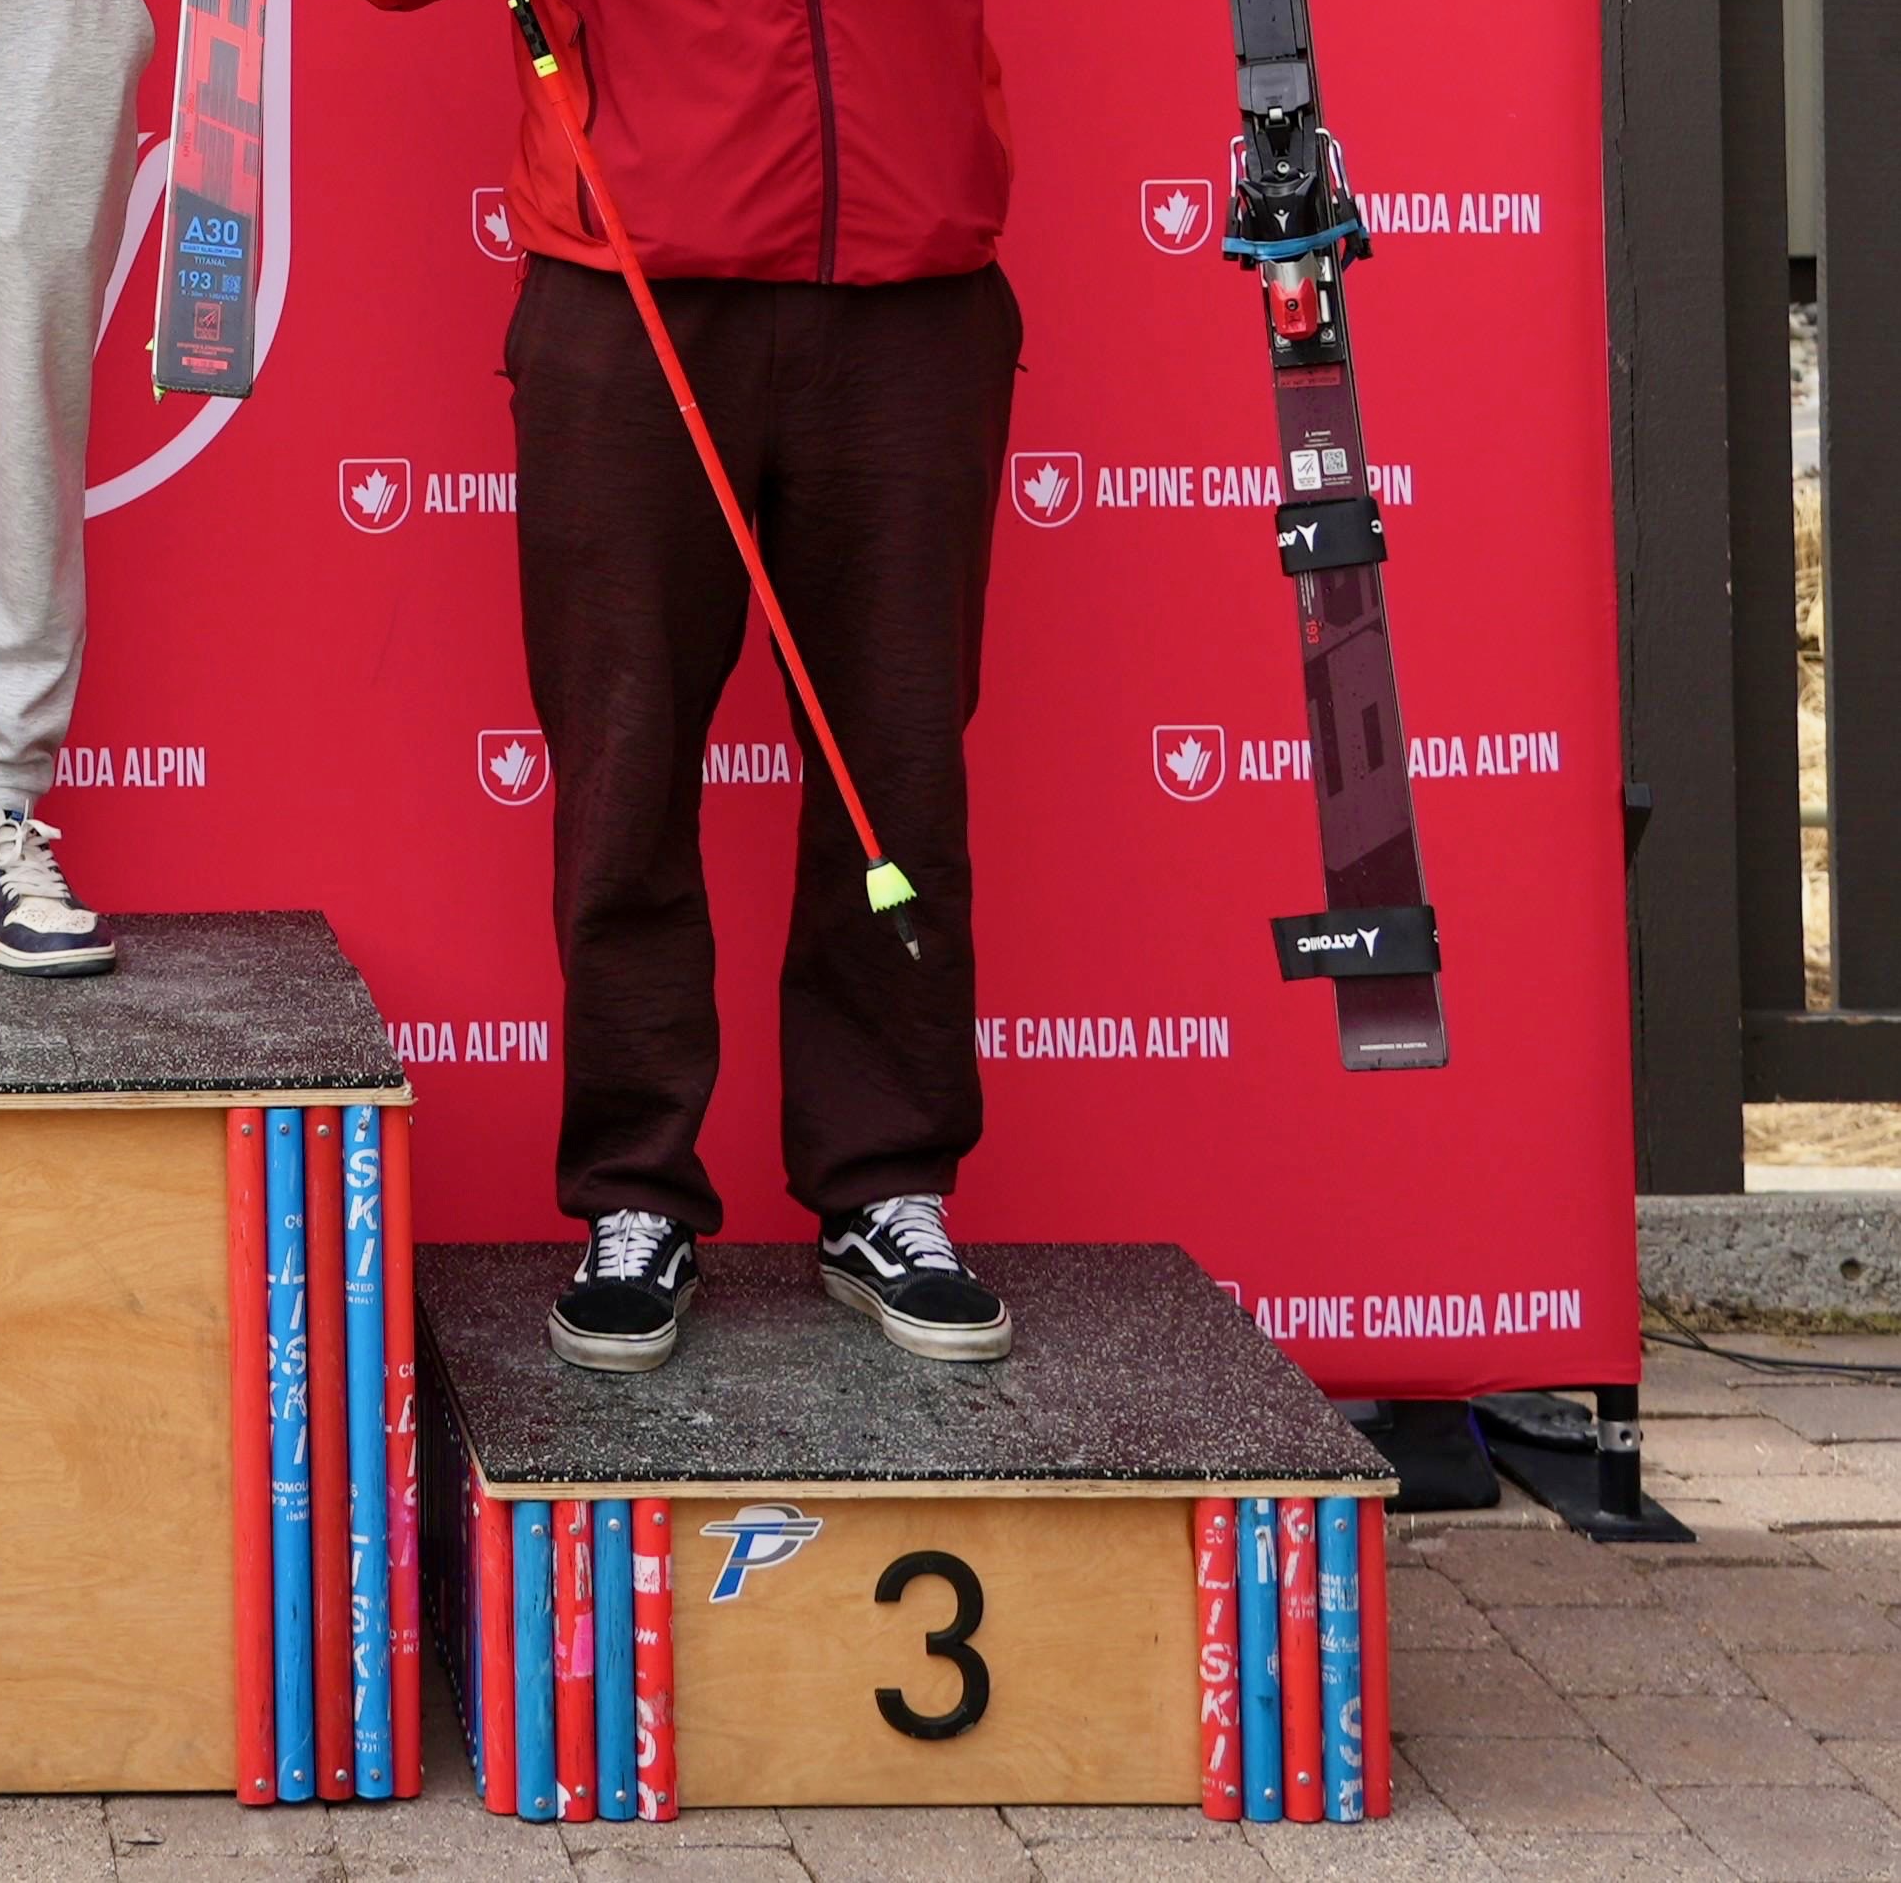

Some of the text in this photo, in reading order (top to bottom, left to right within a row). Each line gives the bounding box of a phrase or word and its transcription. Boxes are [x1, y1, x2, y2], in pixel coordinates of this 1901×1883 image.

[184, 216, 239, 246] A30
[1356, 193, 1540, 234] ANADA ALPIN
[178, 270, 212, 290] 193
[1096, 465, 1412, 507] ALPINE CANA PIN
[56, 747, 205, 787] ADA ALPIN
[1239, 731, 1559, 781] ALPIN ADA ALPIN
[465, 1021, 548, 1062] ALPIN
[1016, 1017, 1137, 1058] CANADA
[1146, 1017, 1229, 1058] ALPIN
[1255, 1289, 1580, 1339] ALPINE CANADA ALPIN
[873, 1550, 991, 1742] 3
